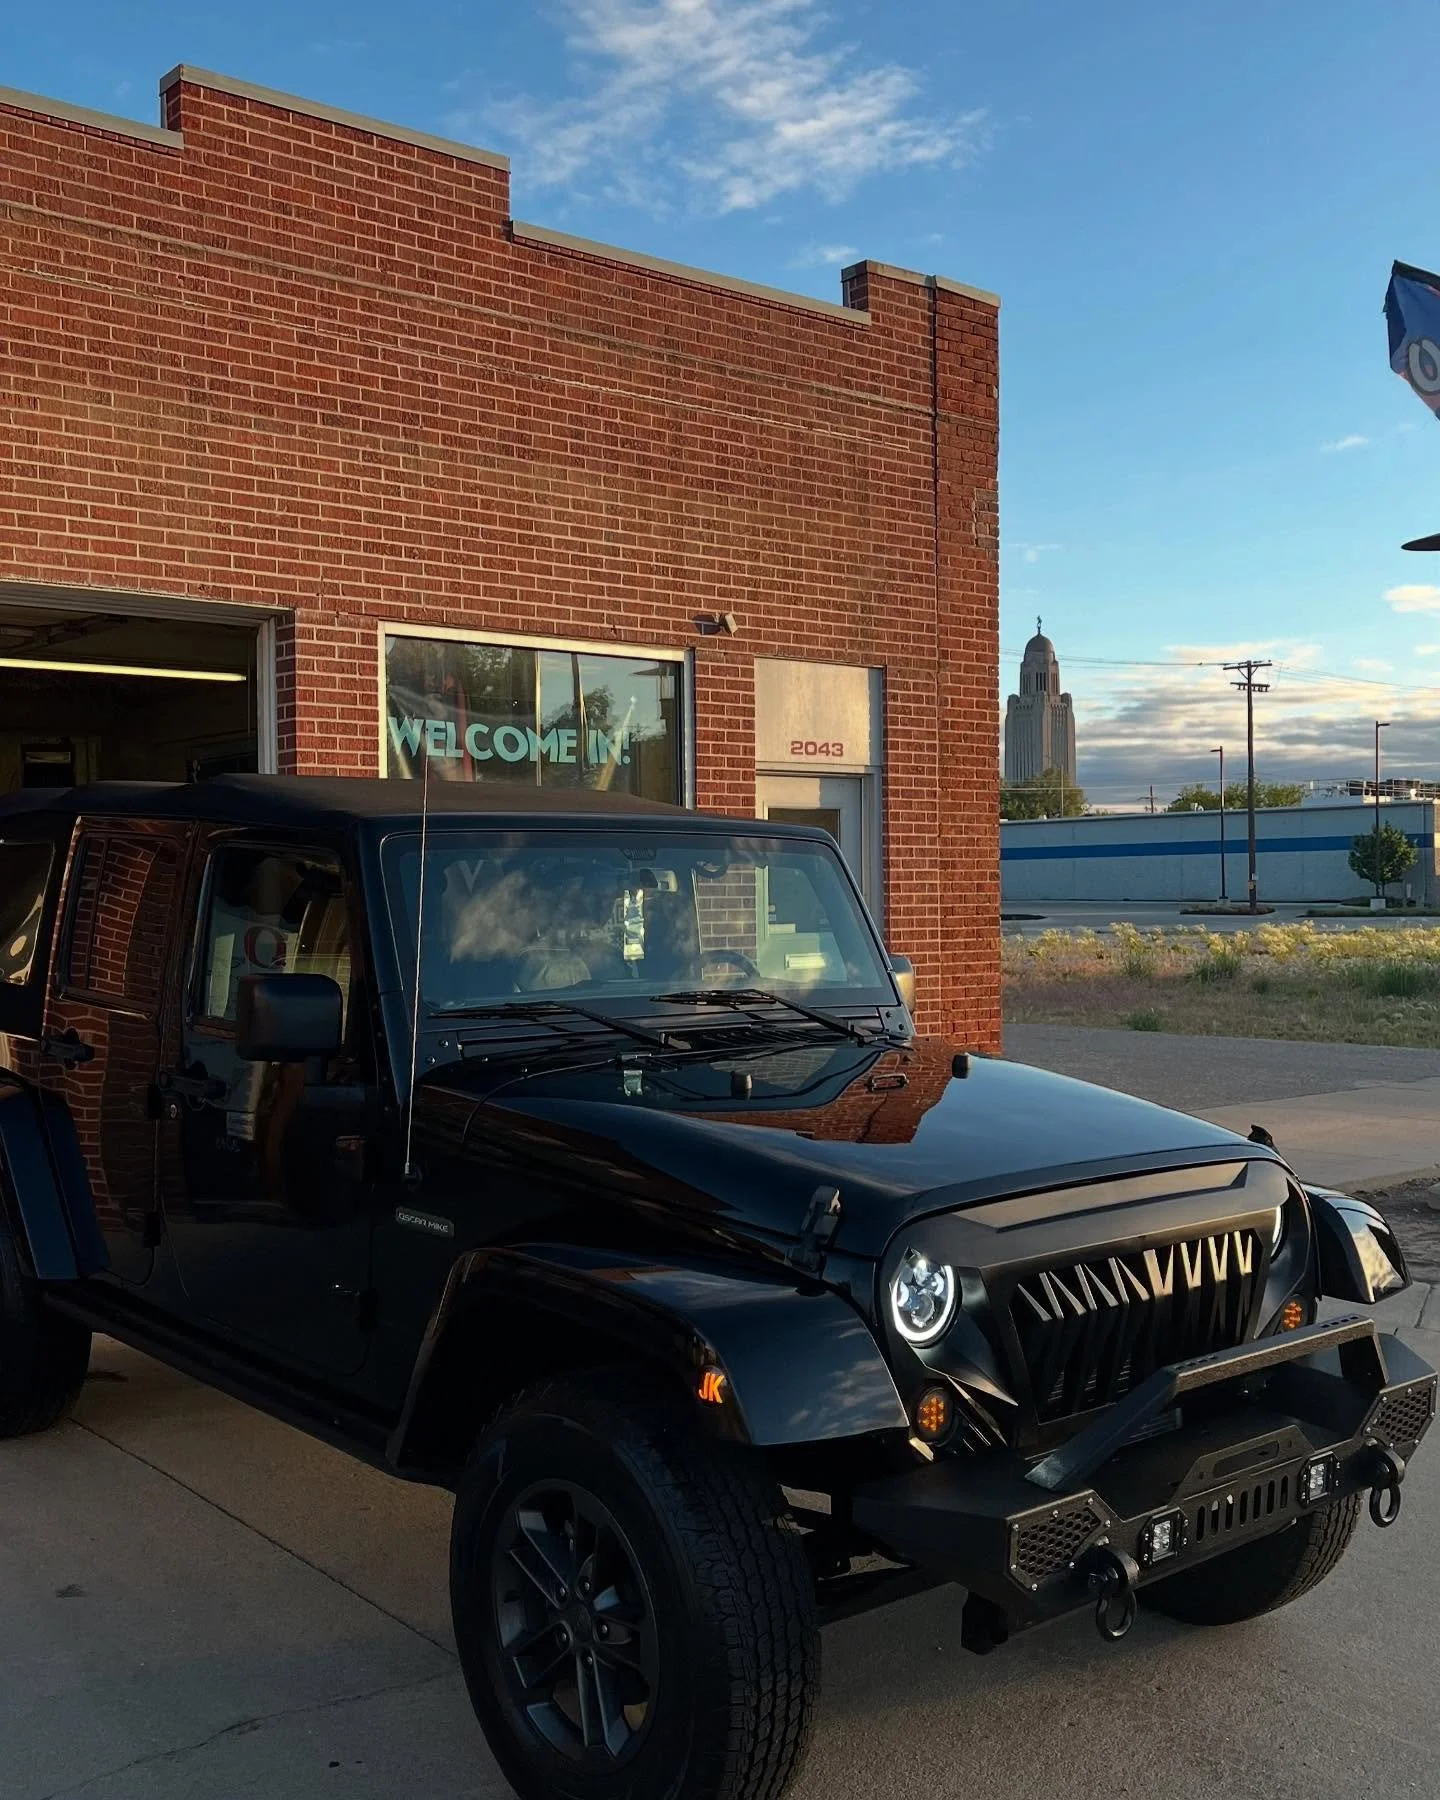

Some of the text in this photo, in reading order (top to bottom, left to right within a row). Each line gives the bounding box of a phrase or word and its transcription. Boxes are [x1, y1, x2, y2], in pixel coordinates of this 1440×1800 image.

[388, 716, 631, 765] WELCOME IN!
[790, 740, 844, 757] 2043
[428, 1221, 449, 1233] MIKE
[698, 1372, 725, 1404] JK
